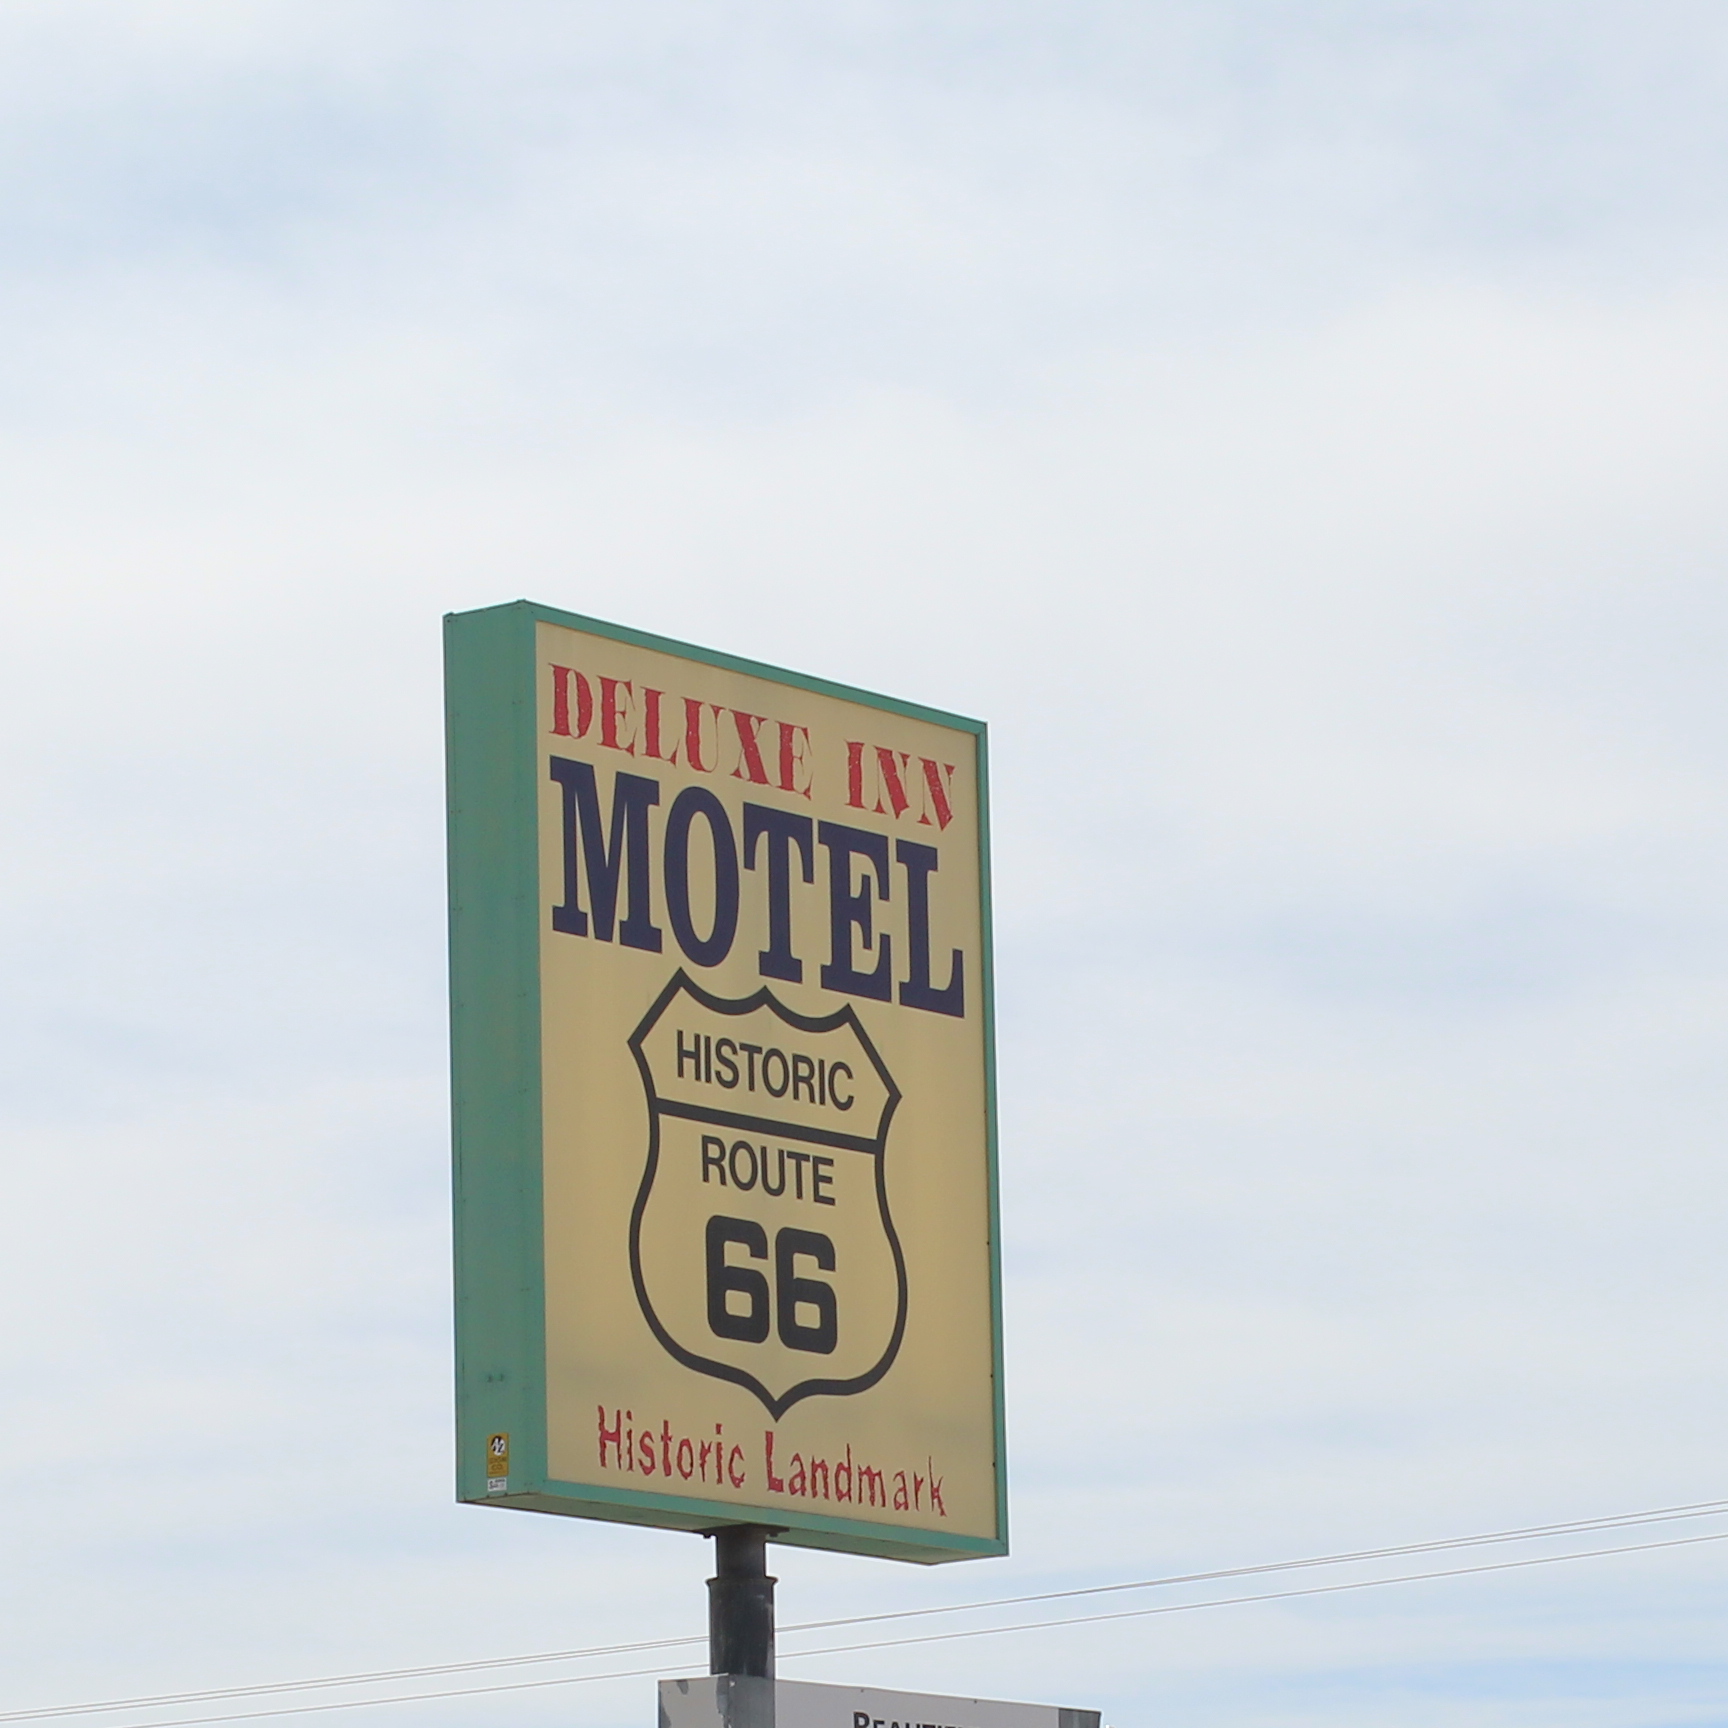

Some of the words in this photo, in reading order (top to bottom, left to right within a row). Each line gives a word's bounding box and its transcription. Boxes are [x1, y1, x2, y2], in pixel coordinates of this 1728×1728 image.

[548, 662, 813, 800] DELUXE
[844, 738, 956, 832] INN
[548, 755, 965, 1019] MOTEL
[675, 1029, 855, 1112] HISTORIC
[701, 1134, 837, 1207] ROUTE
[704, 1213, 839, 1356] 66
[597, 1404, 746, 1489] Historic
[764, 1430, 948, 1518] Landmark
